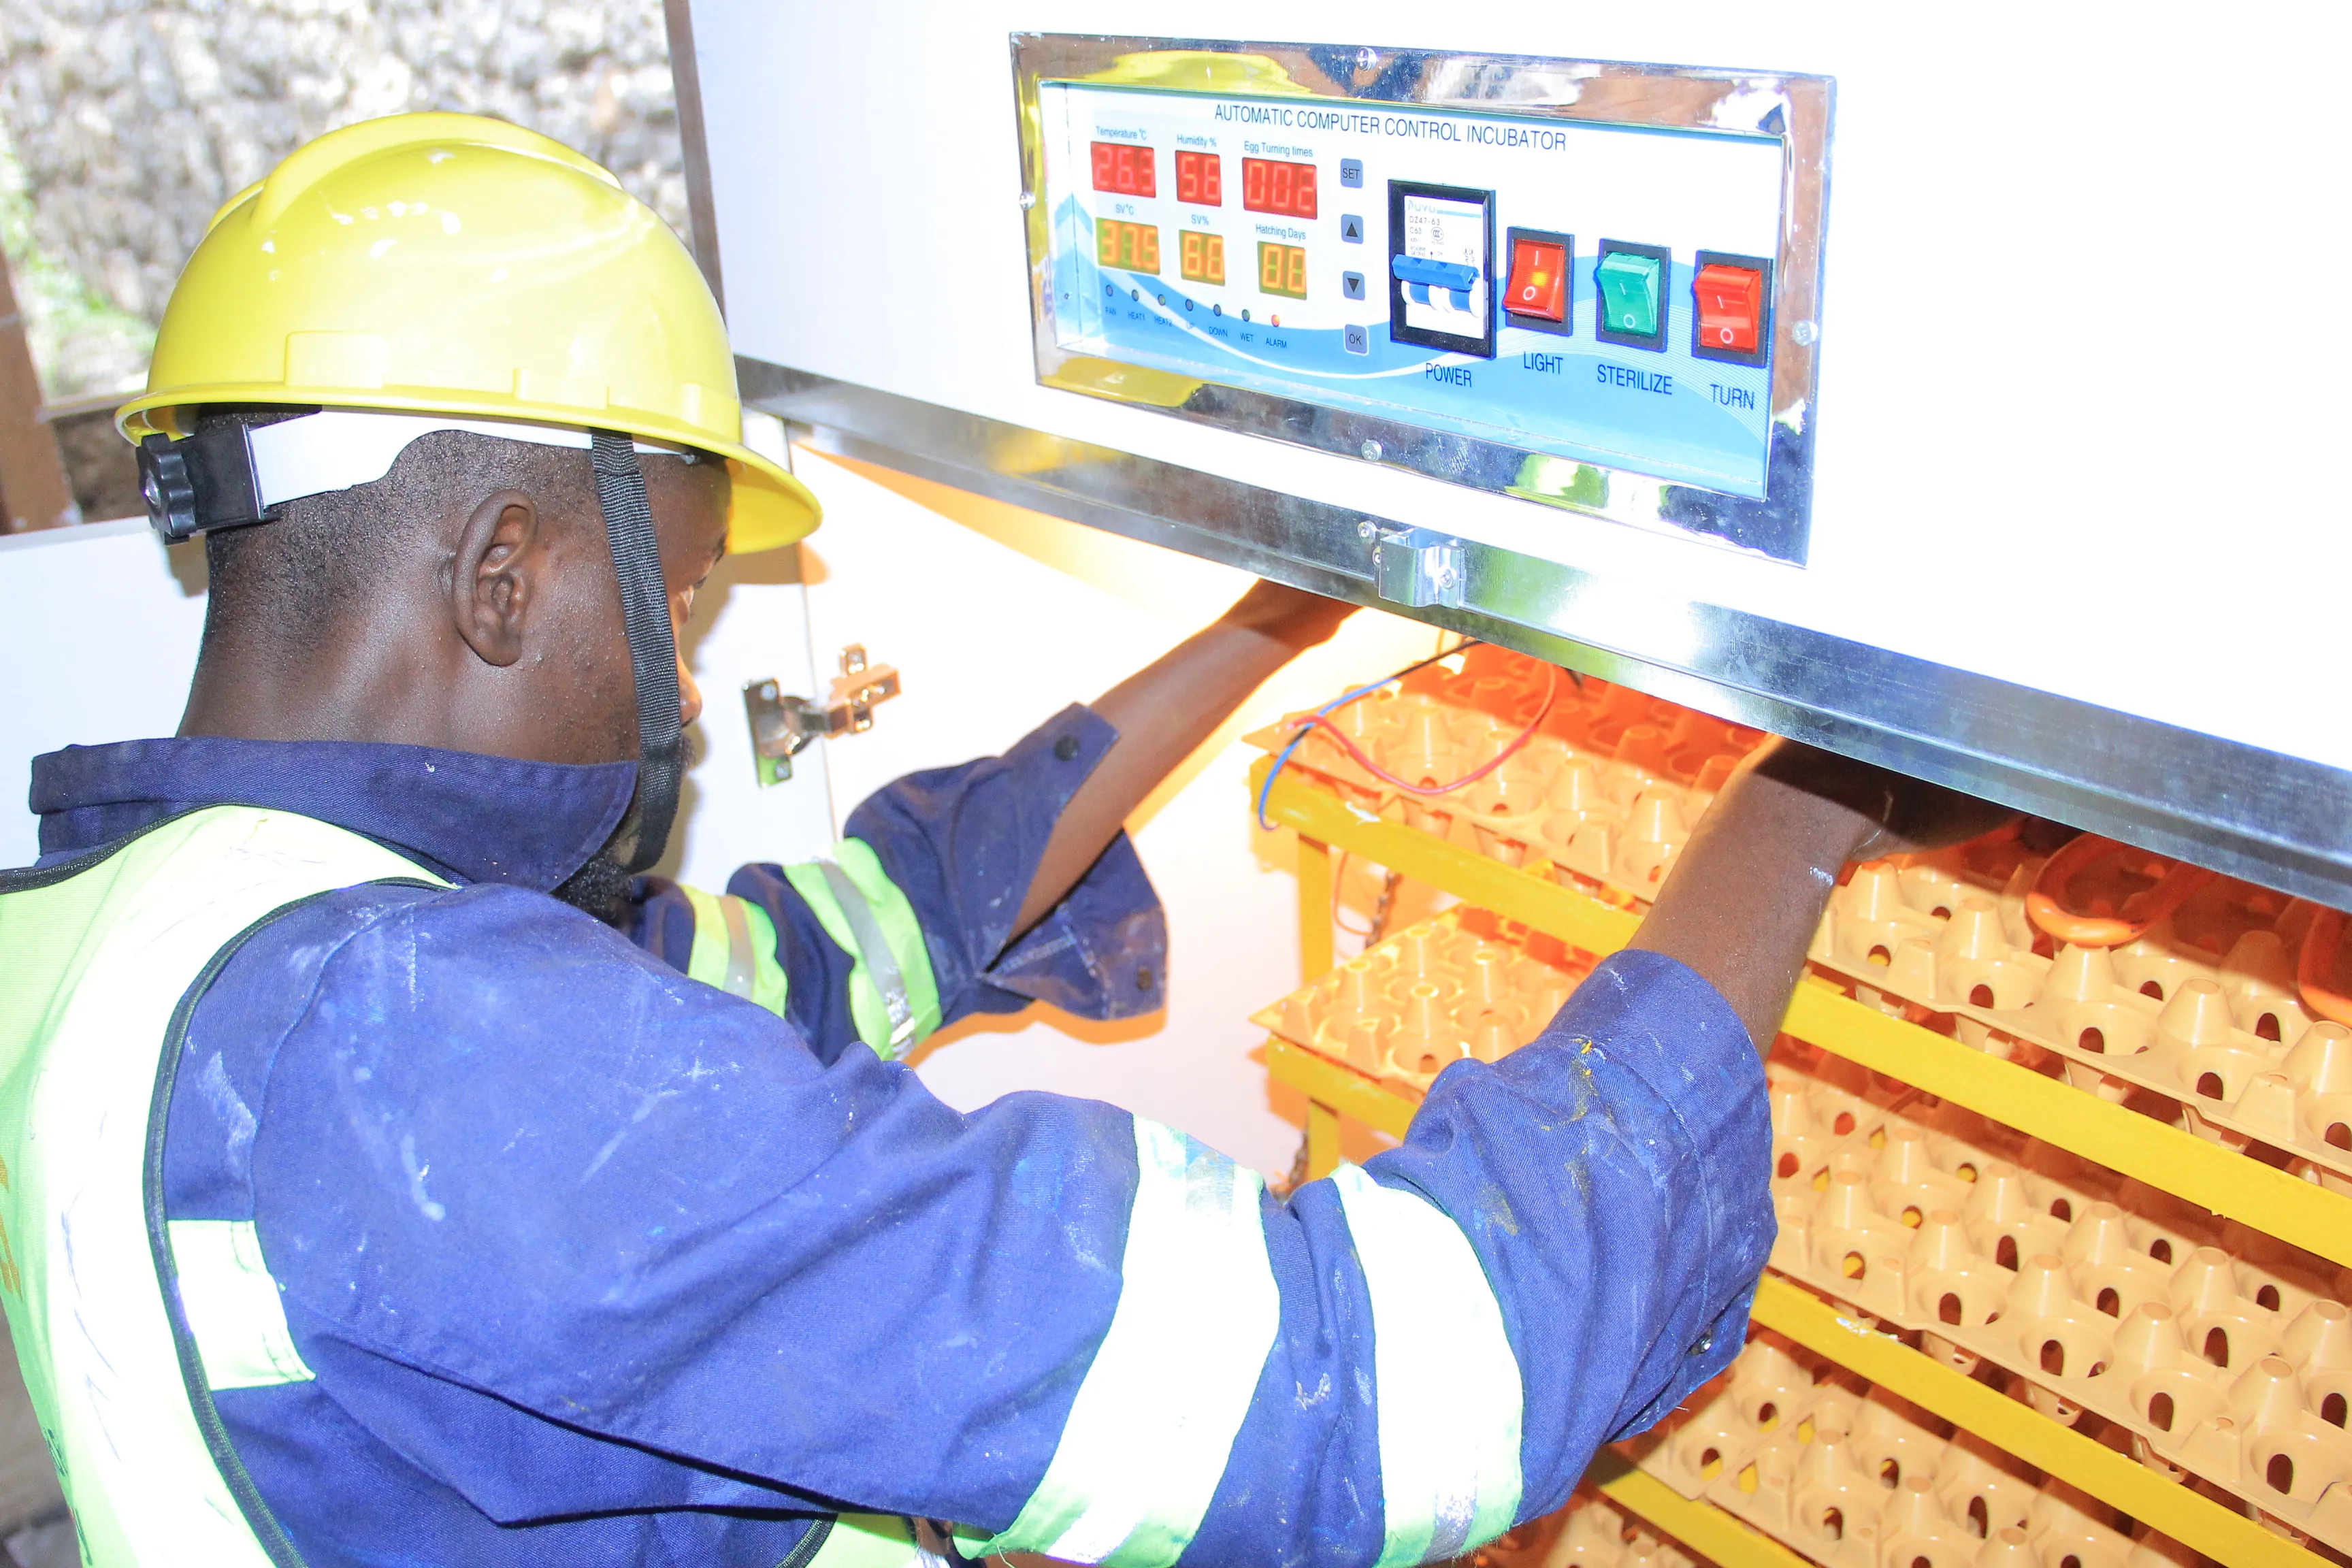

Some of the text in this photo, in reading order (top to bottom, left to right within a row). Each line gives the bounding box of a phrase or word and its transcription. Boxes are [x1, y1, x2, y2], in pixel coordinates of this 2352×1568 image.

[1096, 126, 1137, 140] Temperature
[1215, 104, 1567, 151] AUTOMATIC COMPUTER CONTROL INCUBATOR
[1177, 134, 1217, 148] Humidity %
[1244, 141, 1313, 157] Egg Turning times
[1180, 154, 1221, 200] 56
[1342, 168, 1359, 180] SET
[1247, 161, 1316, 211] 002
[1191, 214, 1209, 225] SV%
[1409, 216, 1440, 225] DZ47-63
[1256, 224, 1306, 241] Hatching Days
[1409, 227, 1422, 235] C63
[1183, 231, 1224, 280] 60
[1105, 307, 1116, 316] FAN
[1128, 311, 1145, 321] HEAT1
[1209, 327, 1228, 337] DOWN
[1240, 332, 1253, 342] WET
[1349, 333, 1362, 345] OK
[1265, 338, 1287, 348] ALARM
[1523, 350, 1563, 375] LIGHT
[1426, 363, 1472, 387] POWER
[1597, 364, 1672, 395] STERILIZE
[1710, 384, 1754, 409] TURN
